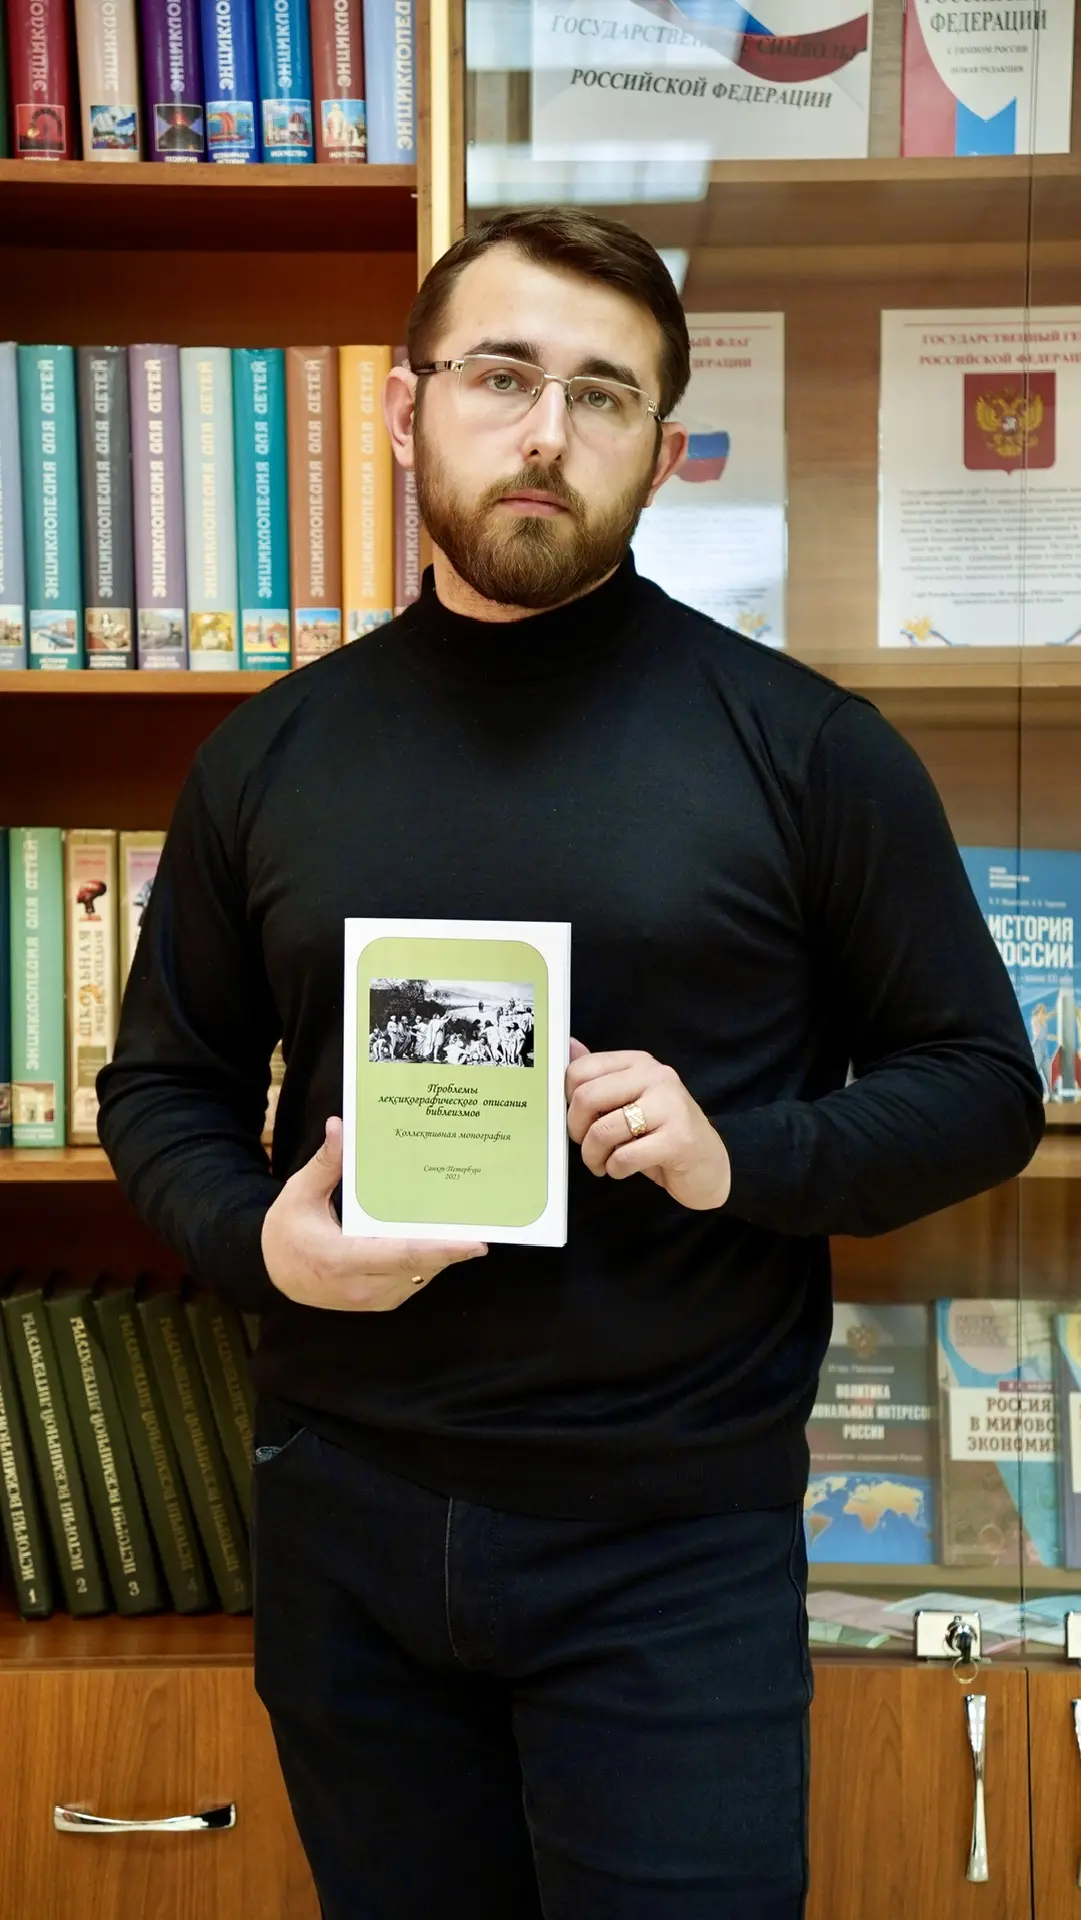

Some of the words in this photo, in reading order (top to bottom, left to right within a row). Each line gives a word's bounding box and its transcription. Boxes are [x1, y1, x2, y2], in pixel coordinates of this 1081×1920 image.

[550, 14, 749, 50] ГОСУДАРСТВЕЕ
[930, 9, 1048, 34] ФЕДЕРАЦИИ
[30, 0, 48, 92] ЭНЦИКЛО
[101, 0, 119, 92] ЭНЦИКЛО
[166, 0, 185, 93] ЭНЦИКЛО
[570, 68, 708, 98] РОССИЙСКОЙ
[712, 82, 834, 110] ФЕДЕРАЦИИ
[1063, 331, 1081, 343] ГЕ
[691, 358, 752, 369] ДЕРАЦИИ
[919, 353, 1012, 366] РОССИЙСКОЙ
[38, 359, 55, 414] ДЕТЕЙ
[144, 359, 162, 413] ДЕТЕЙ
[251, 360, 268, 415] ДЕТЕЙ
[42, 420, 56, 454] ДЛЯ
[149, 420, 163, 454] ДЛЯ
[255, 421, 269, 455] ДЛЯ
[43, 461, 58, 599] ЭНЦИКЛОПЕДИЯ
[150, 460, 167, 598] ЭНЦИКЛОПЕДИЯ
[256, 461, 272, 599] ЭНЦИКЛОПЕДИЯ
[405, 469, 420, 597] ЭНЦИКЛОПЕДИ
[23, 837, 38, 889] ДЕТЕЙ
[25, 896, 39, 929] ДЛЯ
[988, 914, 1073, 942] ИСТОРИЯ
[25, 936, 40, 1071] ЭНЦИКЛОПЕДИЯ
[378, 1094, 478, 1107] лексикографического
[482, 1099, 528, 1108] описания
[427, 1083, 478, 1096] Проблемы
[425, 1106, 480, 1118] библеизмов
[393, 1128, 457, 1139] Коллективная
[458, 1131, 511, 1142] монография
[423, 1165, 481, 1176] Санкт-Петербург
[21, 1312, 54, 1409] ЛИТЕРАТУРЫ
[69, 1316, 102, 1413] ЛИТЕРАТУРЫ
[986, 1397, 1052, 1413] РОССИЯ
[842, 1424, 885, 1440] РОССИИ
[969, 1416, 981, 1433] В
[40, 1407, 71, 1500] ВСЕМИРНОЙ
[90, 1411, 121, 1504] ВСЕМИРНОЙ
[11, 1509, 35, 1581] ИСТОРИЯ
[60, 1501, 84, 1571] ИСТОРИЯ
[111, 1505, 136, 1575] ИСТОРИЯ
[28, 1588, 37, 1604] 1
[76, 1577, 88, 1594] 2
[128, 1580, 140, 1597] 3
